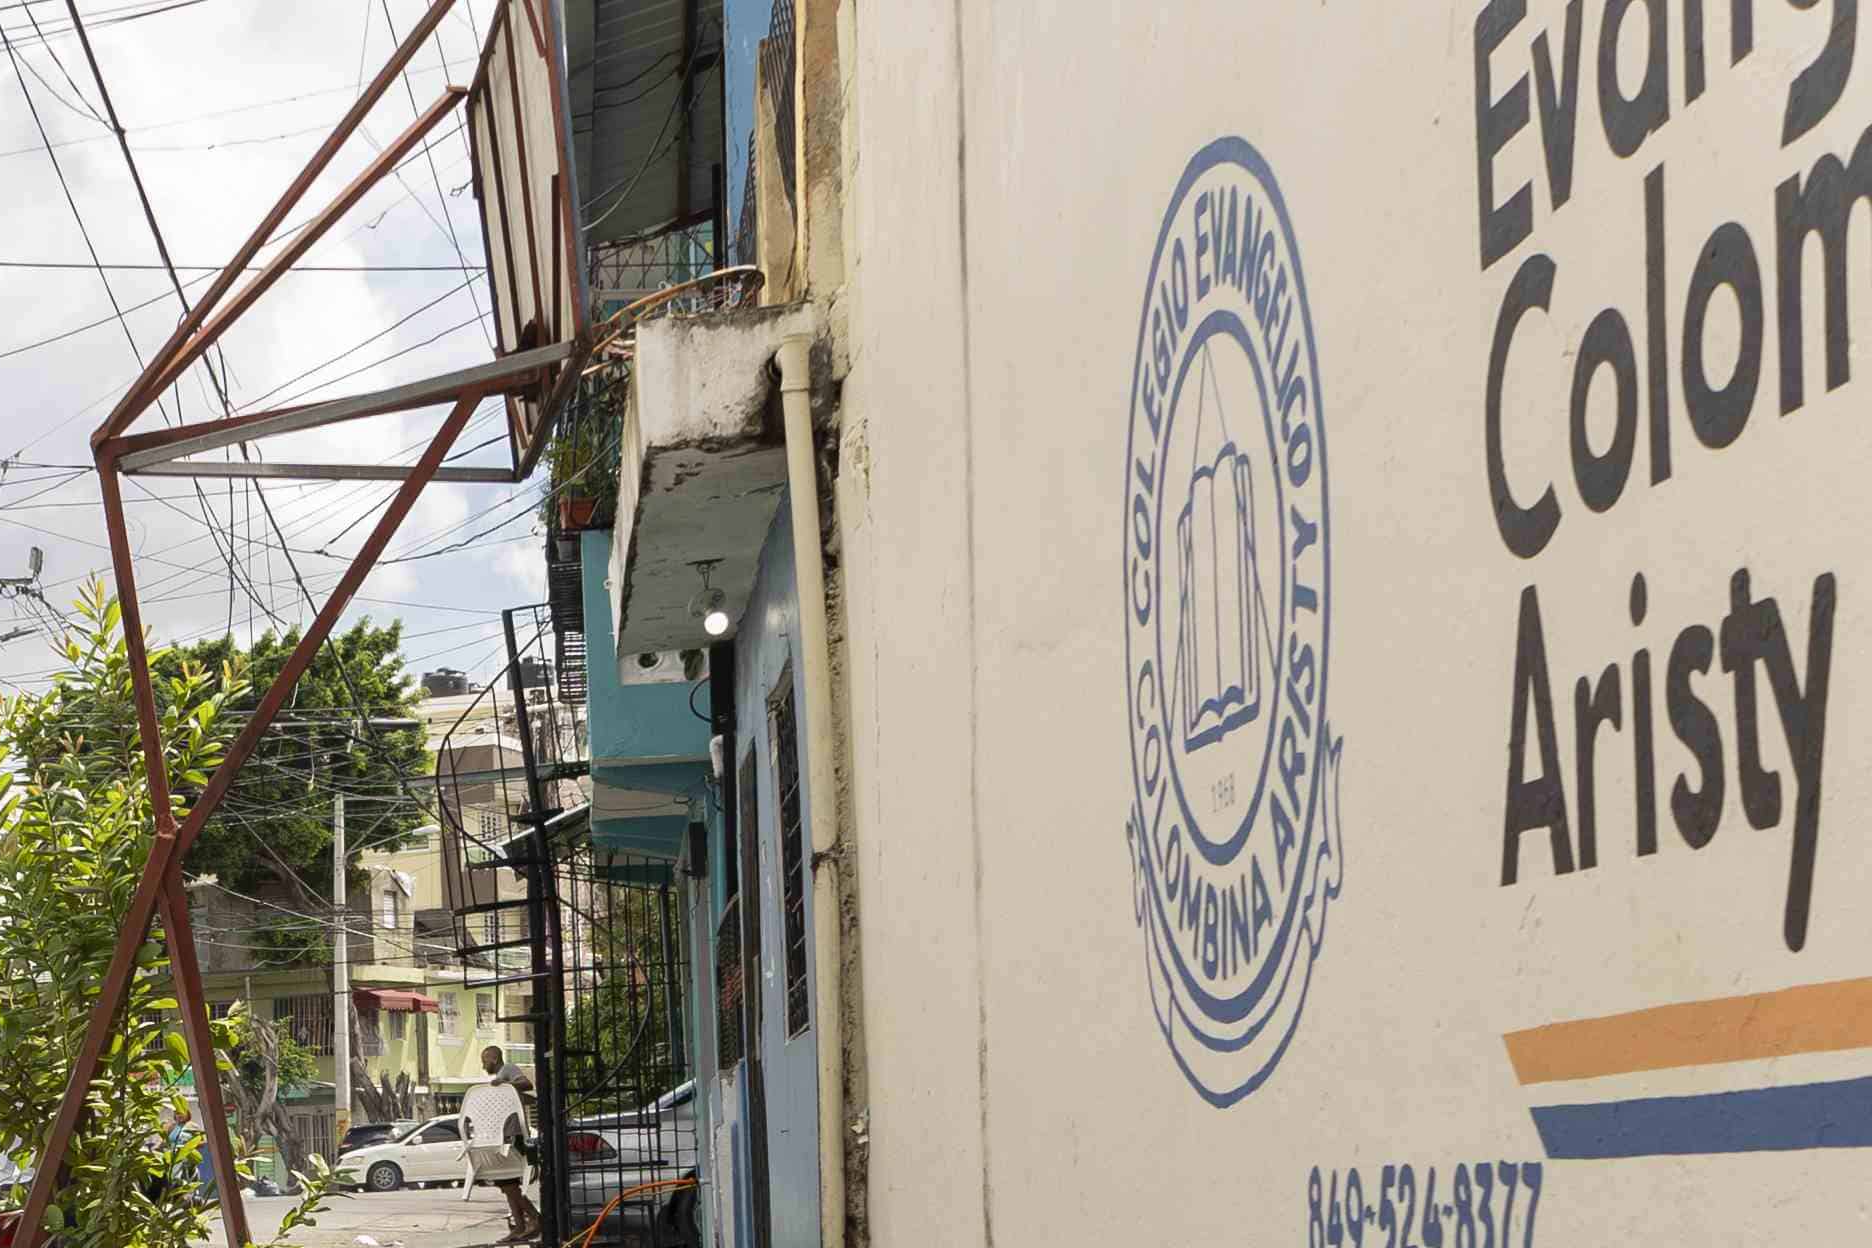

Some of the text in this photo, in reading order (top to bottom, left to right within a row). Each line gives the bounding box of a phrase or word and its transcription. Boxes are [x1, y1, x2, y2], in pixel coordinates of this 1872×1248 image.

[1132, 184, 1313, 627] COLEGIO EVANGELICO
[1136, 503, 1319, 981] COLOMBINA ARISTY
[1500, 567, 1837, 953] Aristy
